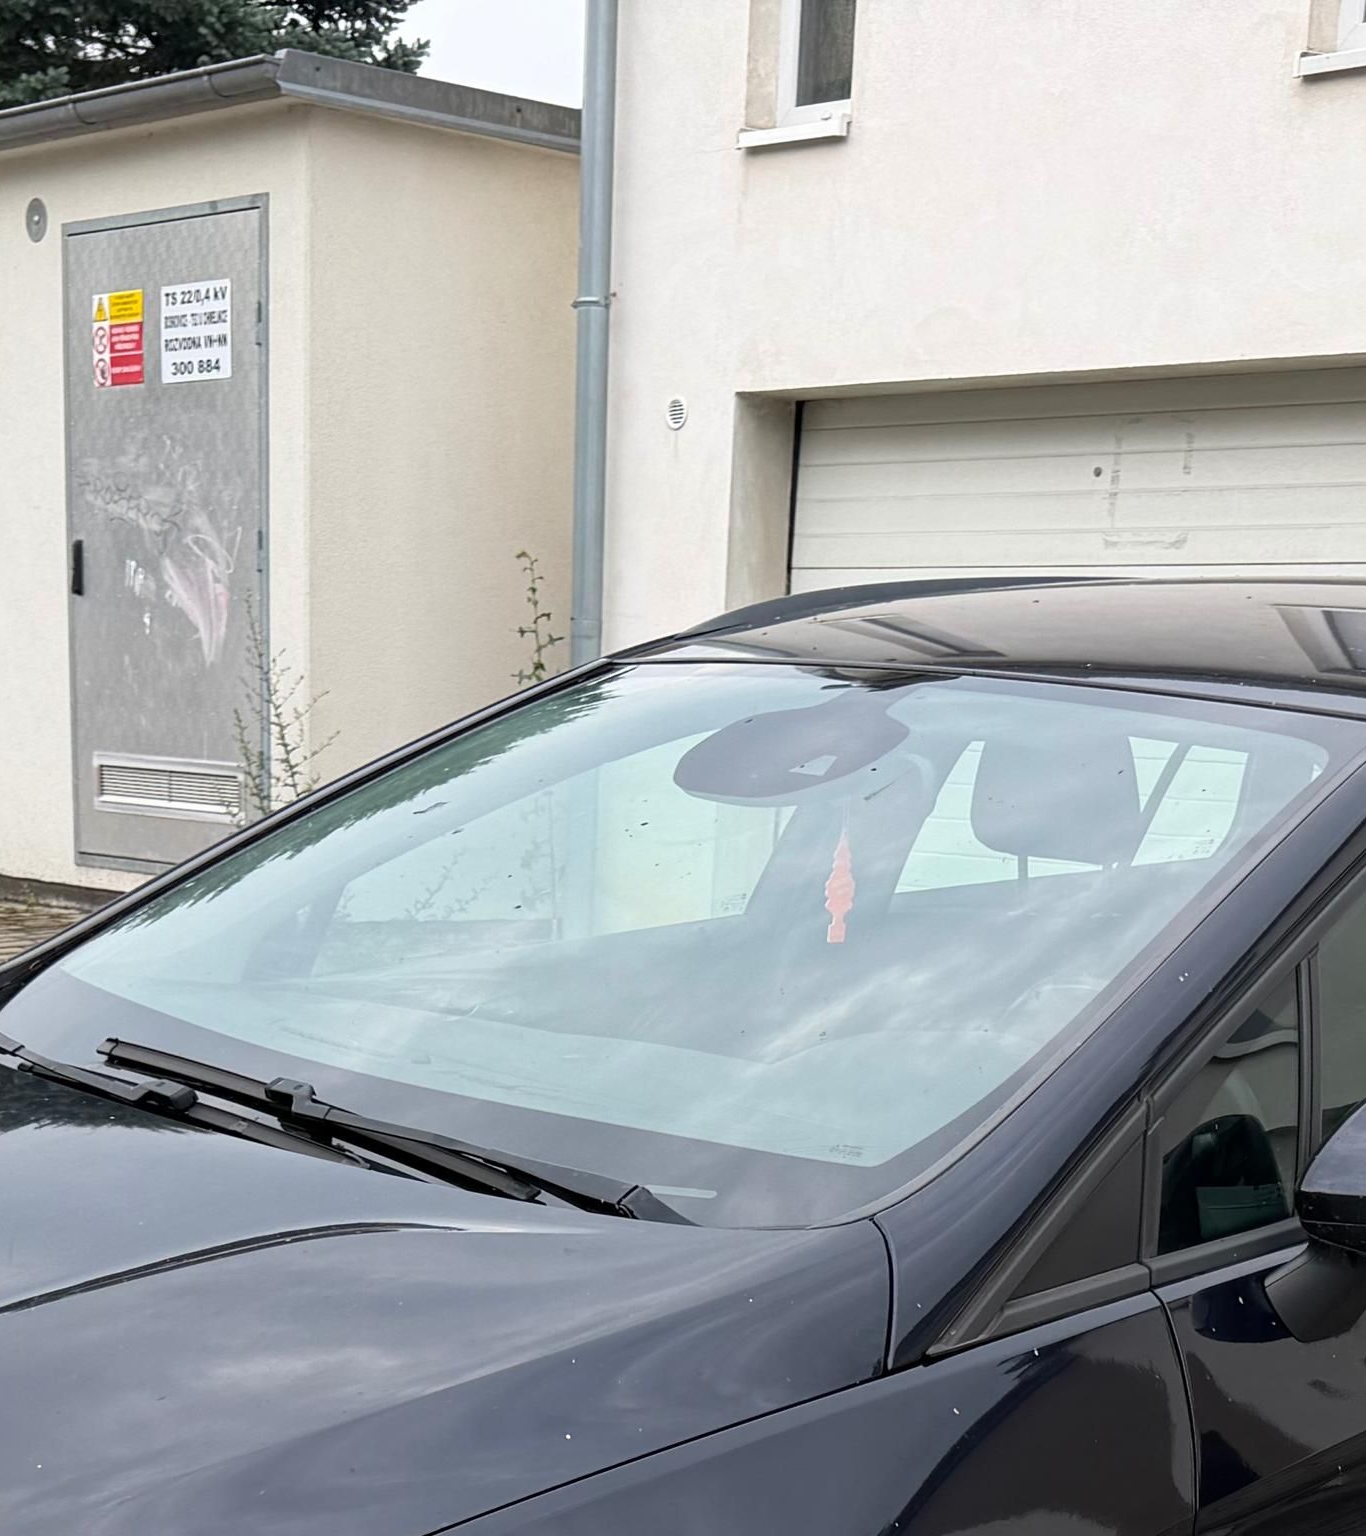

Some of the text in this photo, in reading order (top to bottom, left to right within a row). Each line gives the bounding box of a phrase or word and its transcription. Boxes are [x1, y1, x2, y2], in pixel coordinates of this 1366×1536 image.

[164, 292, 178, 306] TS
[171, 358, 221, 376] 300 884
